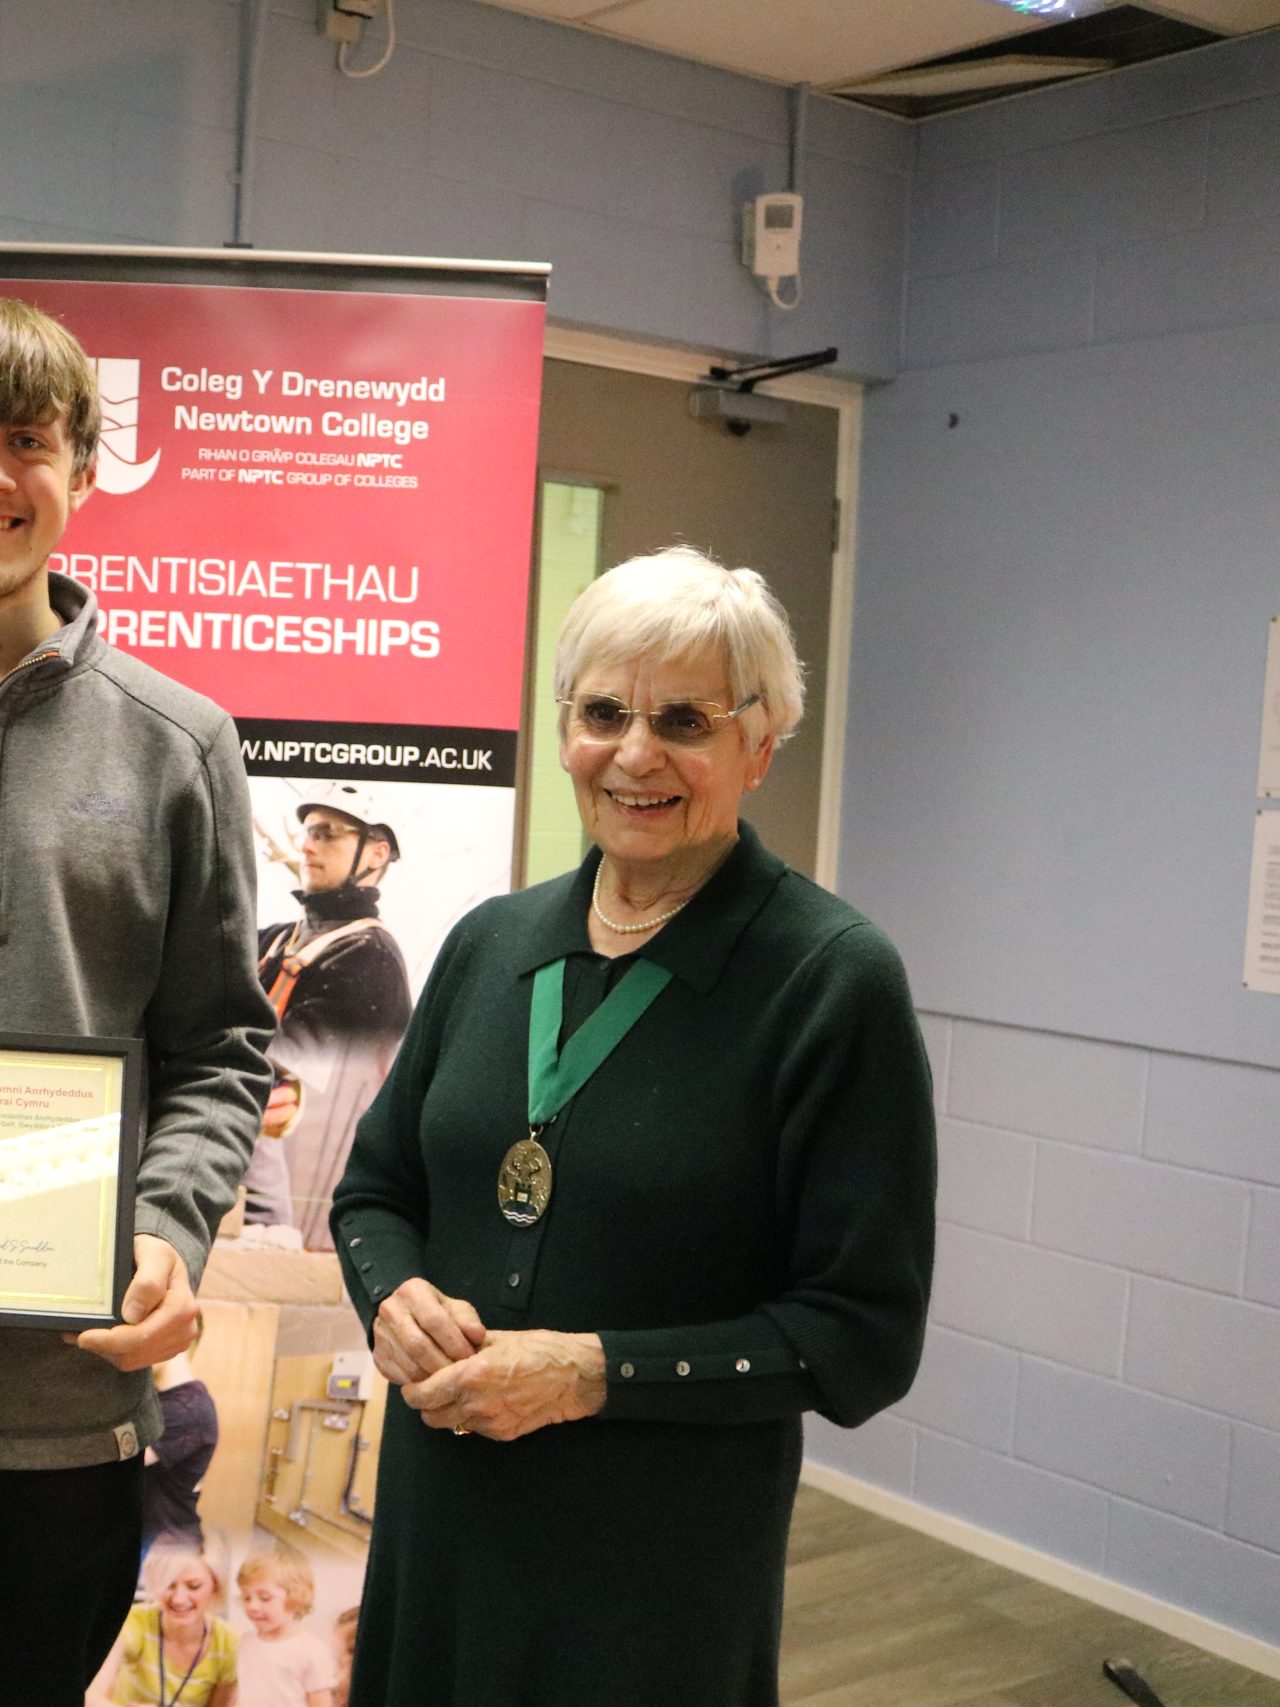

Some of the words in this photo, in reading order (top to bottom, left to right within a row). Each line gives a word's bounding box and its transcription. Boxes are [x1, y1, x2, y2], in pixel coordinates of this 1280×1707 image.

[161, 367, 243, 400] Coleg
[252, 369, 274, 395] Y
[281, 371, 446, 407] Drenewydd
[174, 405, 313, 435] Newtown
[321, 411, 430, 445] College
[198, 447, 237, 461] RHAN
[239, 449, 250, 462] O
[295, 452, 356, 467] COLEGAU
[356, 453, 403, 468] NPTC
[181, 467, 217, 481] PART
[218, 468, 237, 481] OF
[238, 469, 284, 484] NPTC
[286, 471, 333, 486] GROUP
[334, 473, 352, 486] OF
[353, 474, 419, 489] COLLEGES
[24, 1086, 94, 1098] Anrhydeddus
[16, 1098, 50, 1109] Cymru
[16, 1259, 48, 1268] Company
